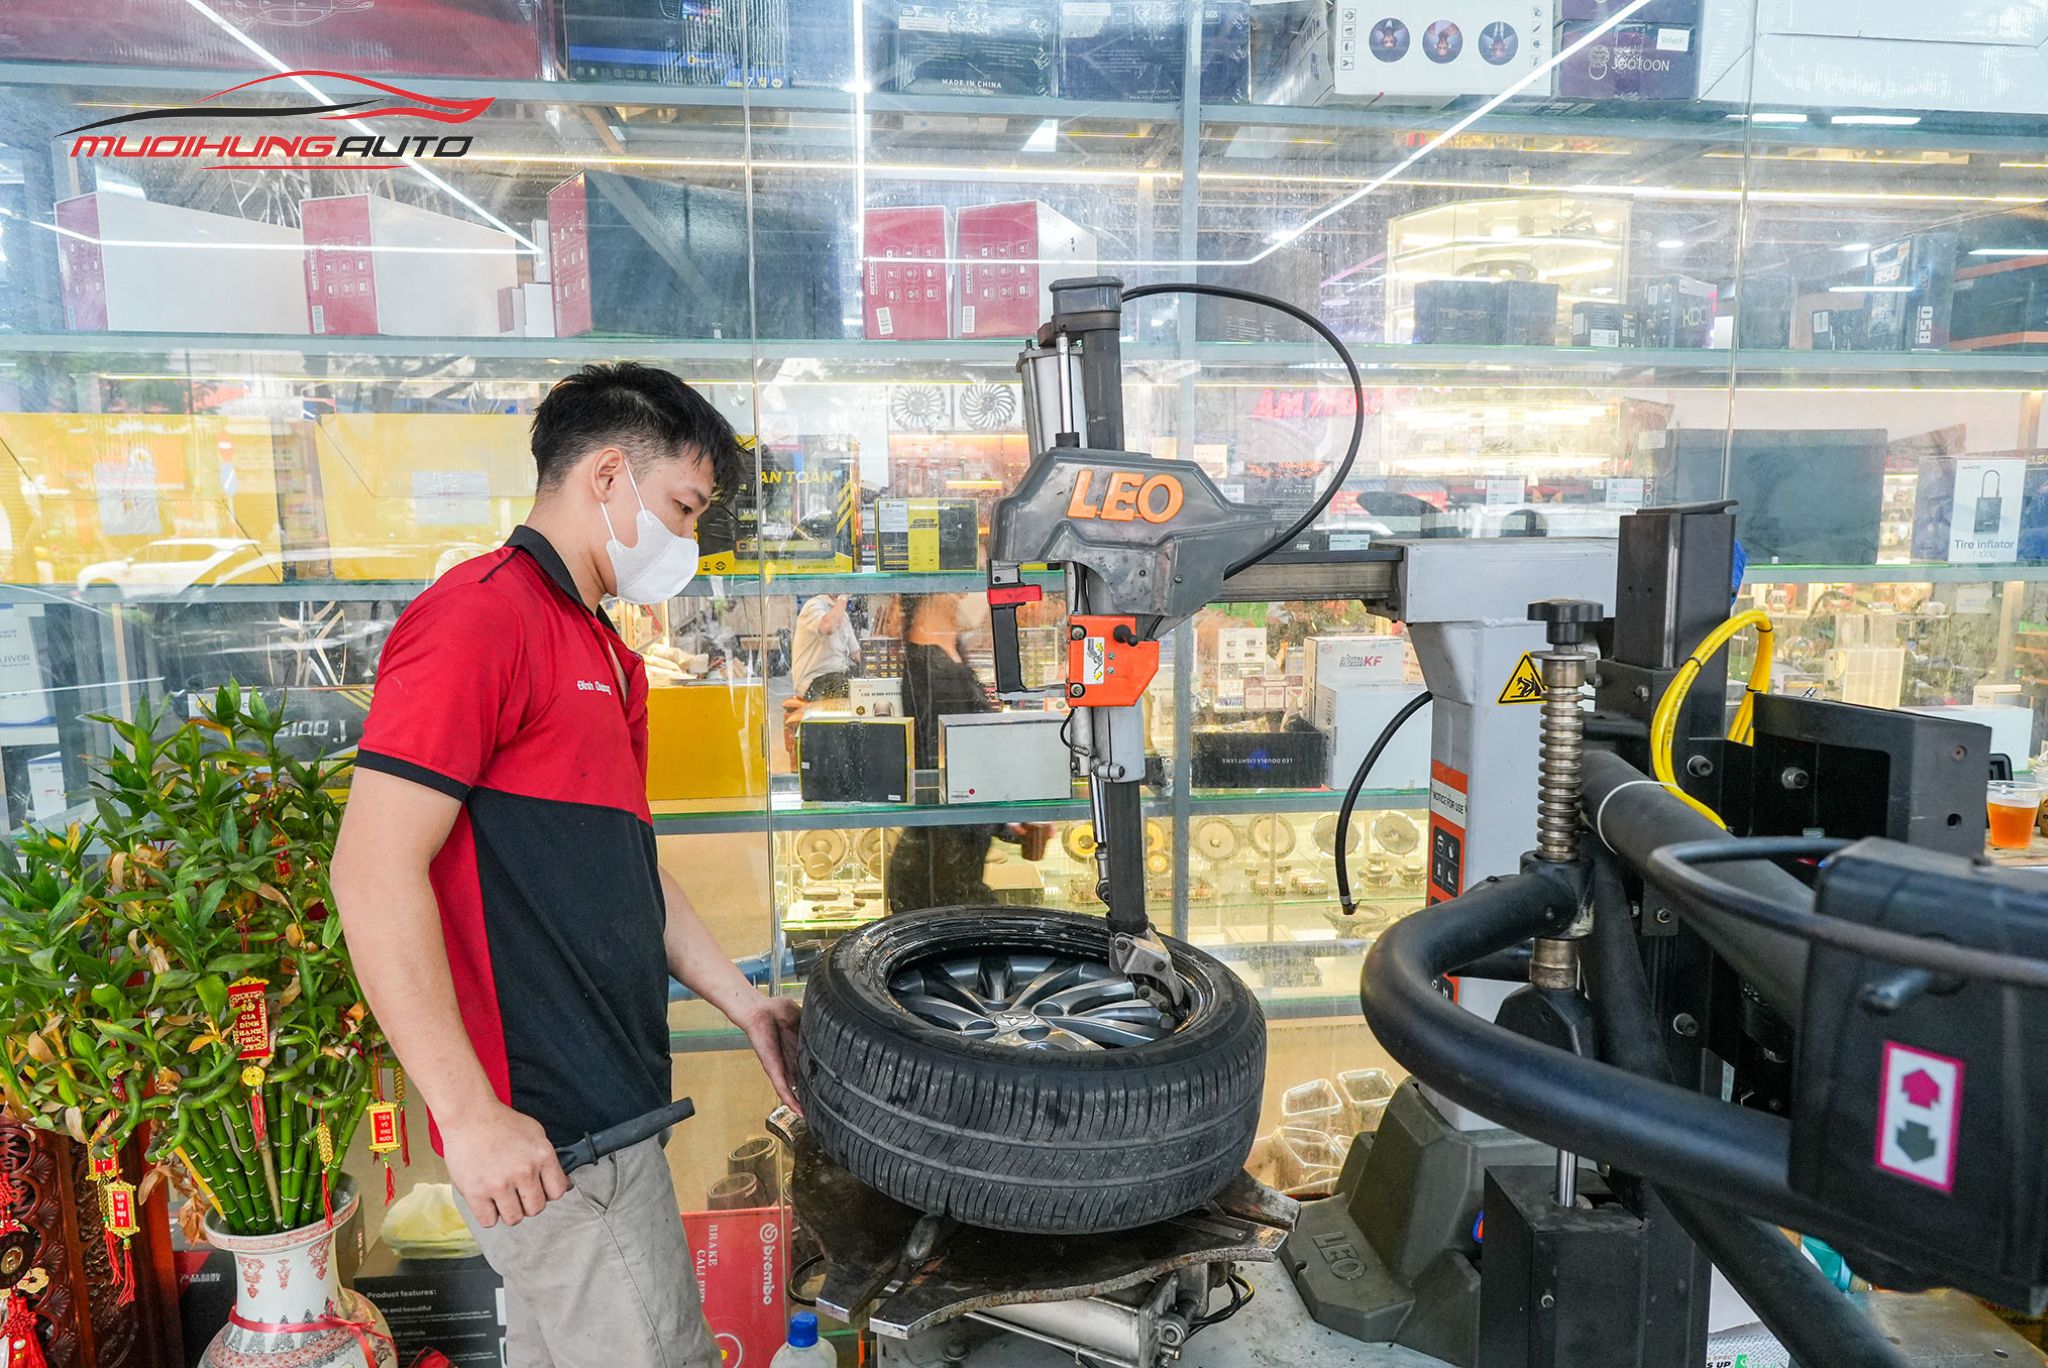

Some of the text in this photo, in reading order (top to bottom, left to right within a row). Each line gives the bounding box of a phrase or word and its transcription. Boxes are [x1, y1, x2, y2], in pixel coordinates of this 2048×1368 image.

[1204, 10, 1218, 18] SGS
[942, 79, 965, 87] MADE
[977, 81, 1002, 89] CHINA
[760, 471, 782, 484] AN
[1067, 470, 1184, 524] LEO
[1954, 539, 2015, 550] Tire inflator
[1364, 656, 1383, 667] KF
[708, 1224, 718, 1266] BRAKE
[1312, 1231, 1366, 1280] LEO
[763, 1245, 775, 1306] brembo
[367, 1289, 437, 1299] Product features:
